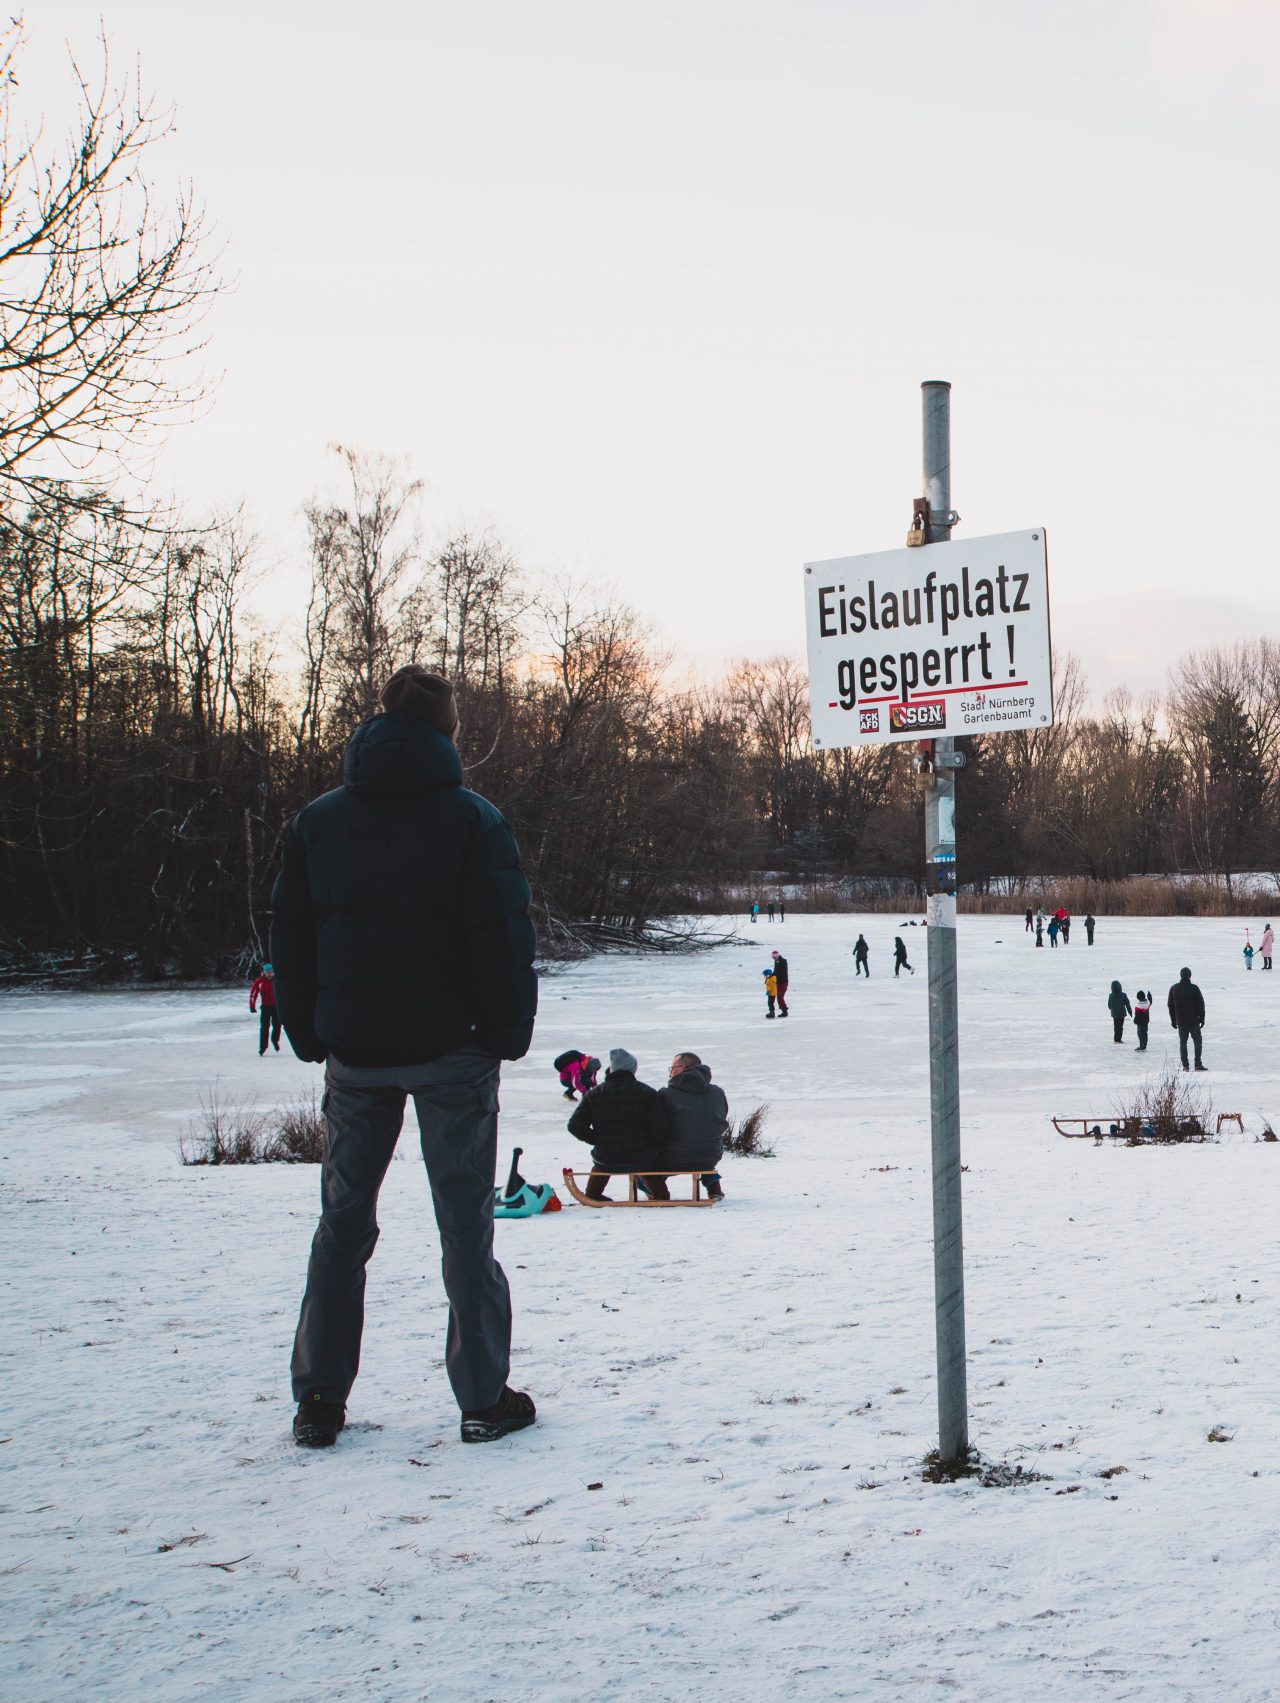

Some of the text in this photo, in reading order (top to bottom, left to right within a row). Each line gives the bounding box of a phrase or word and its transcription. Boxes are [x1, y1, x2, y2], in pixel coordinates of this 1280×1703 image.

[818, 565, 1030, 637] Eislaufplatz
[838, 632, 992, 711] gesperrt
[960, 697, 1035, 712] Stadt Nürnberg
[860, 712, 879, 722] FCK
[906, 704, 942, 724] SGN
[964, 708, 1032, 724] Gartenbauamt
[860, 720, 879, 730] AFD
